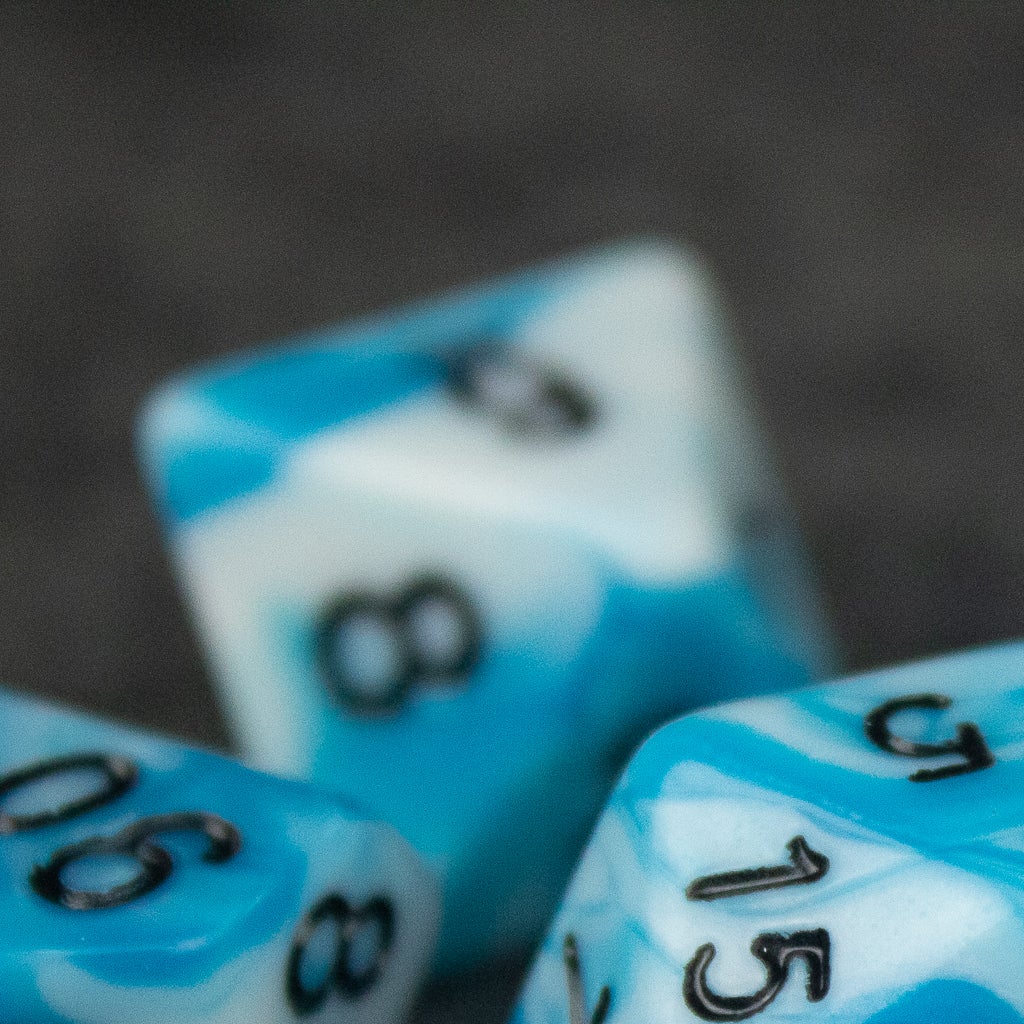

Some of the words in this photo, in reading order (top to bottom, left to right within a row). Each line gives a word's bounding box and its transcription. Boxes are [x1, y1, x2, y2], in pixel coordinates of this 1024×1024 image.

[312, 572, 485, 720] 8
[865, 692, 996, 784] 5
[683, 834, 833, 1023] 15
